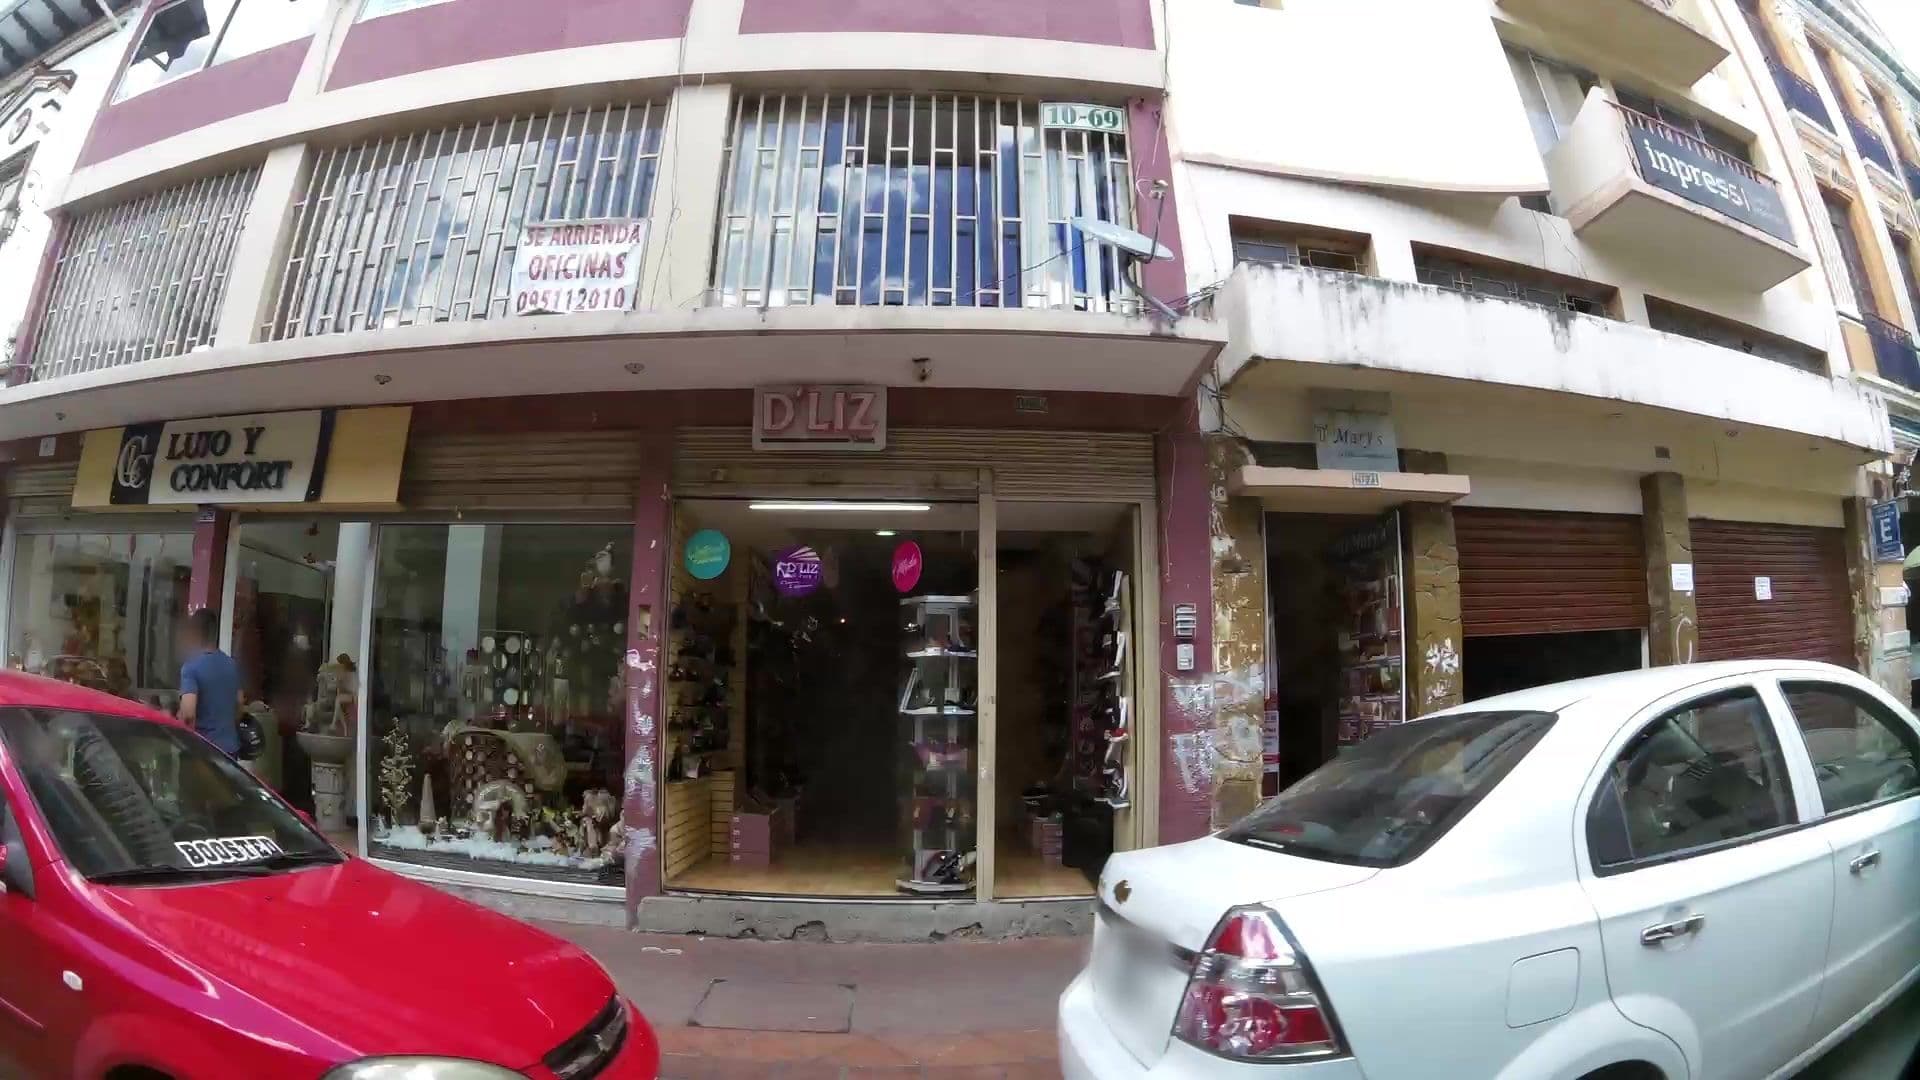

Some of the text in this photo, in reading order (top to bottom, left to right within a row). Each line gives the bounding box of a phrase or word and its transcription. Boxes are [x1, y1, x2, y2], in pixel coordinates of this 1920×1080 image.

[1048, 105, 1118, 128] 10-69
[524, 223, 641, 246] SE ARRIENDA
[529, 252, 627, 281] OFICINAS
[761, 387, 877, 434] D'LIZ
[243, 427, 265, 455] Y
[170, 461, 293, 492] CONFORT
